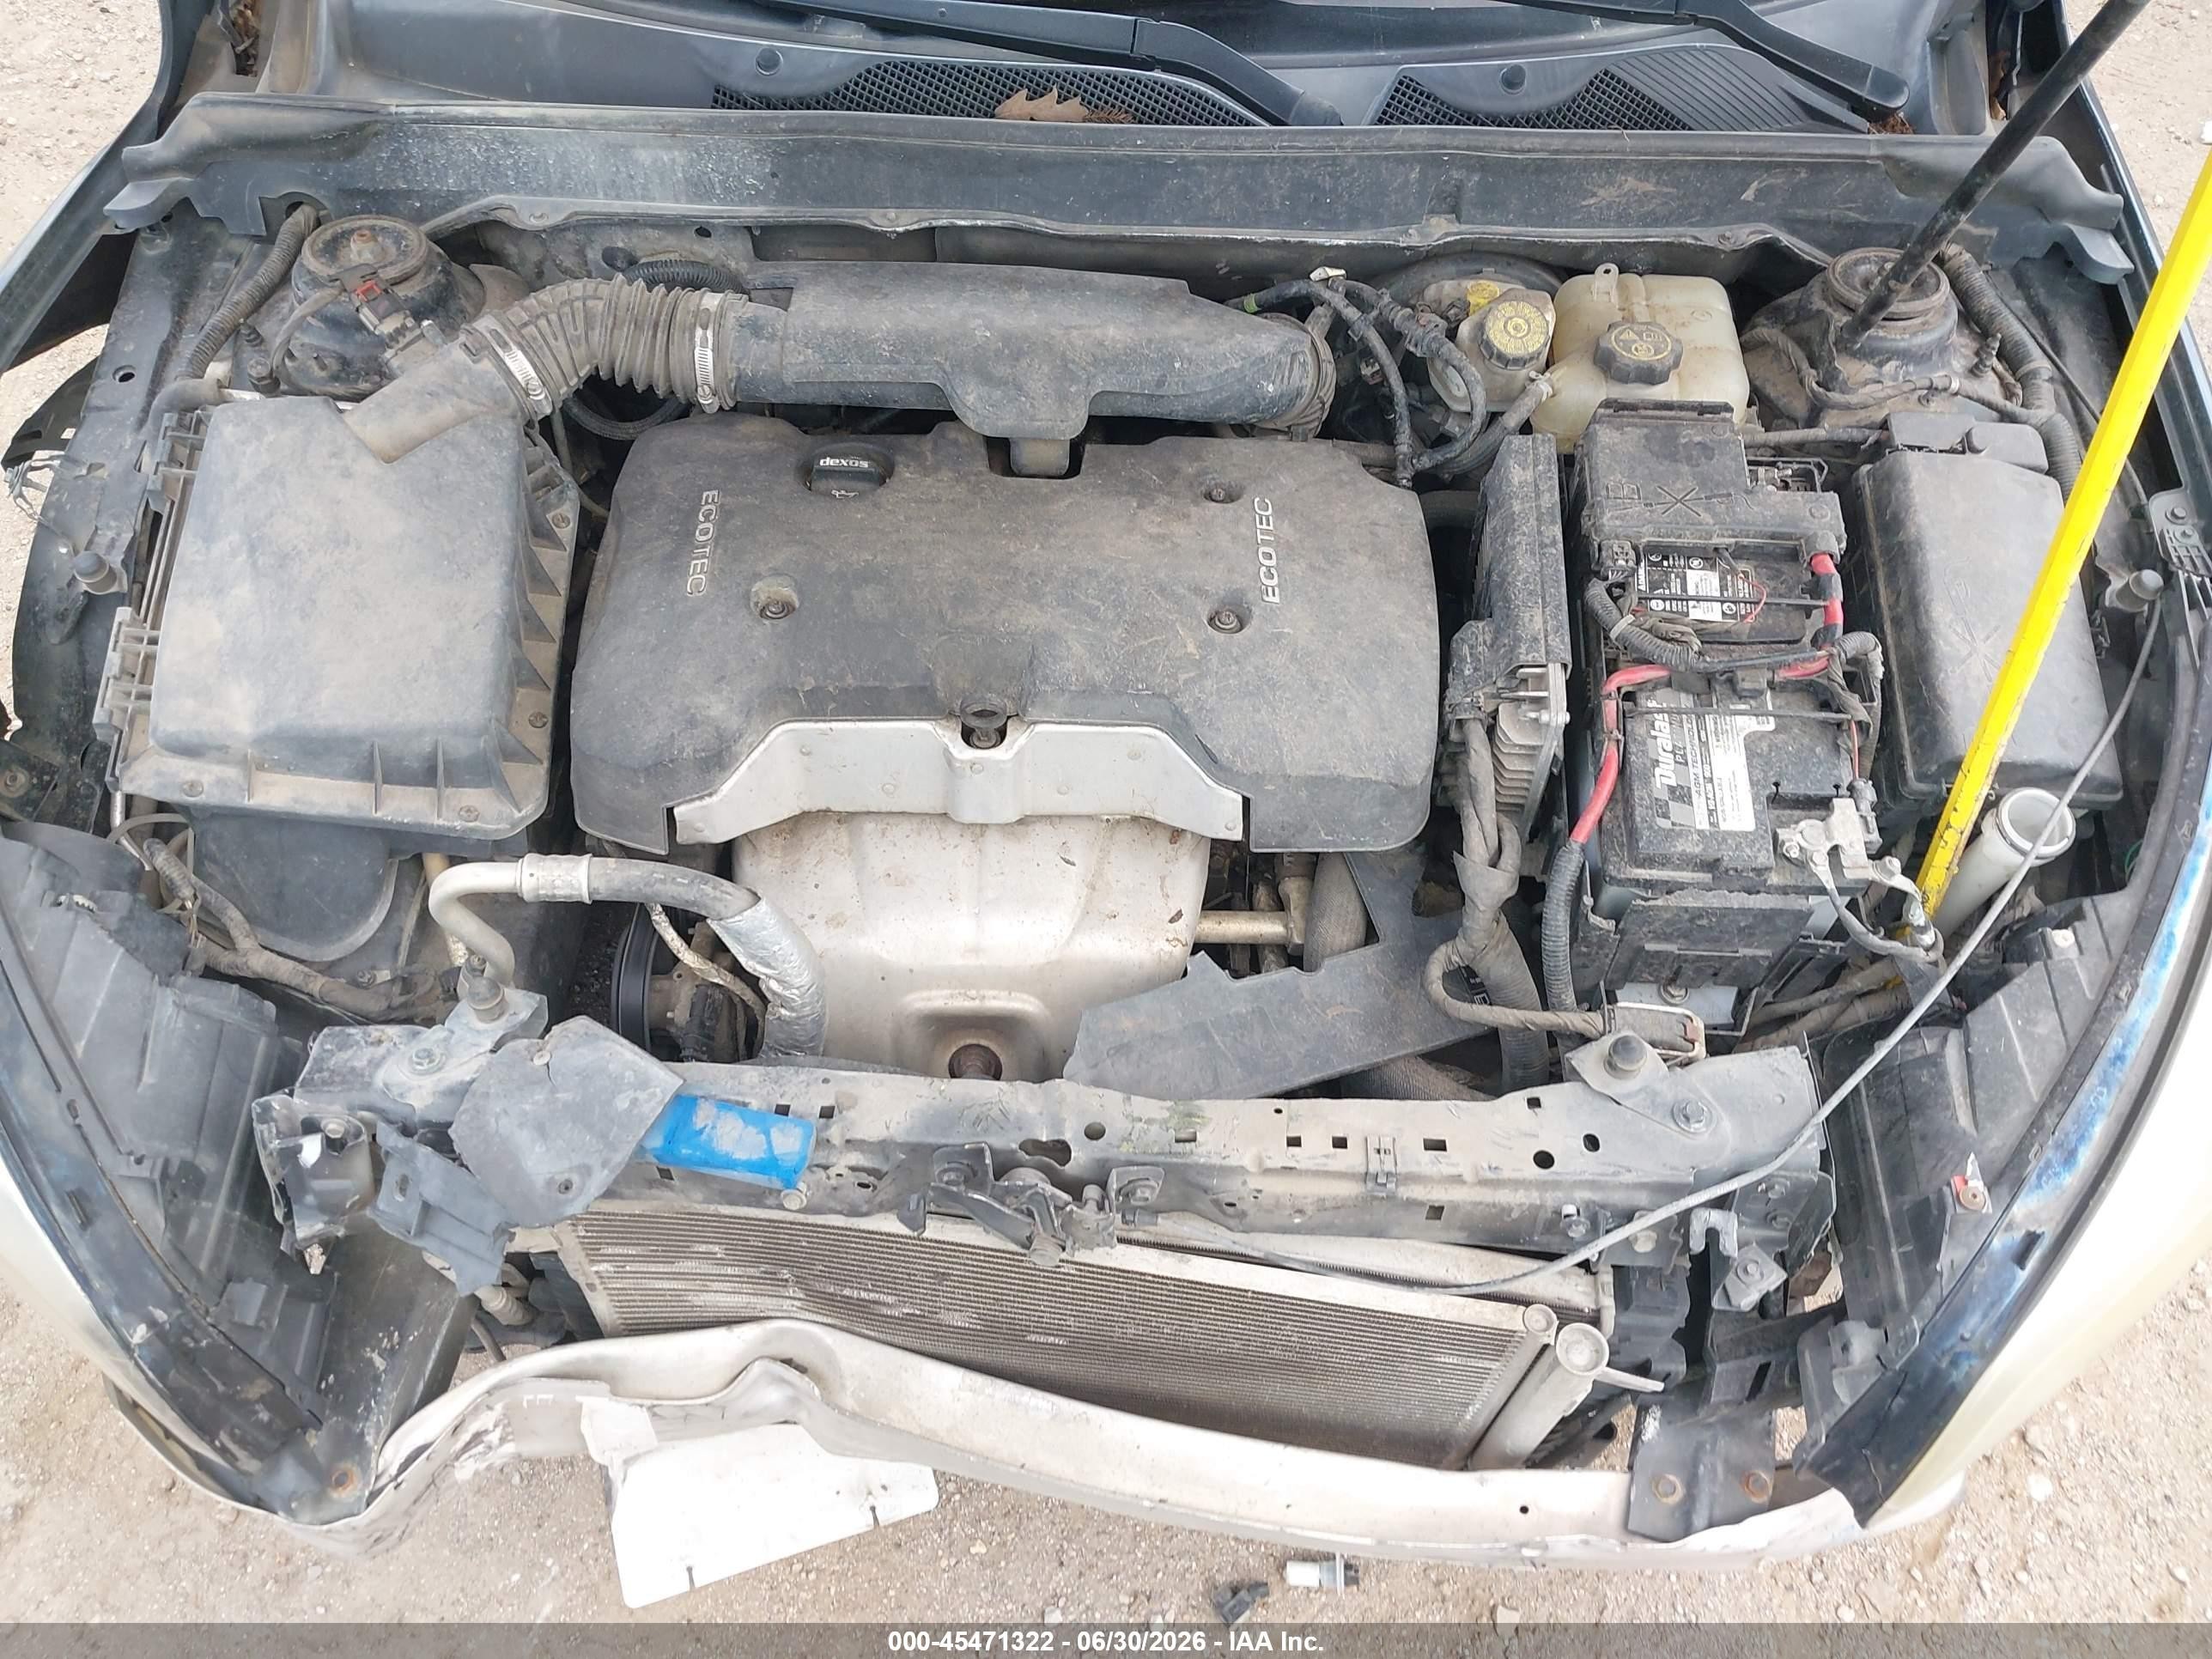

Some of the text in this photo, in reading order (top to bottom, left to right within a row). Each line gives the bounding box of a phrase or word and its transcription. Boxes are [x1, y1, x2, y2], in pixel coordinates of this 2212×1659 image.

[819, 456, 869, 468] dexos
[687, 489, 719, 597] ECOTEC
[1254, 497, 1279, 605] ECOTEC
[1646, 696, 1677, 789] Duralast
[1682, 702, 1699, 769] TECHNOLO
[1692, 774, 1702, 798] AGM
